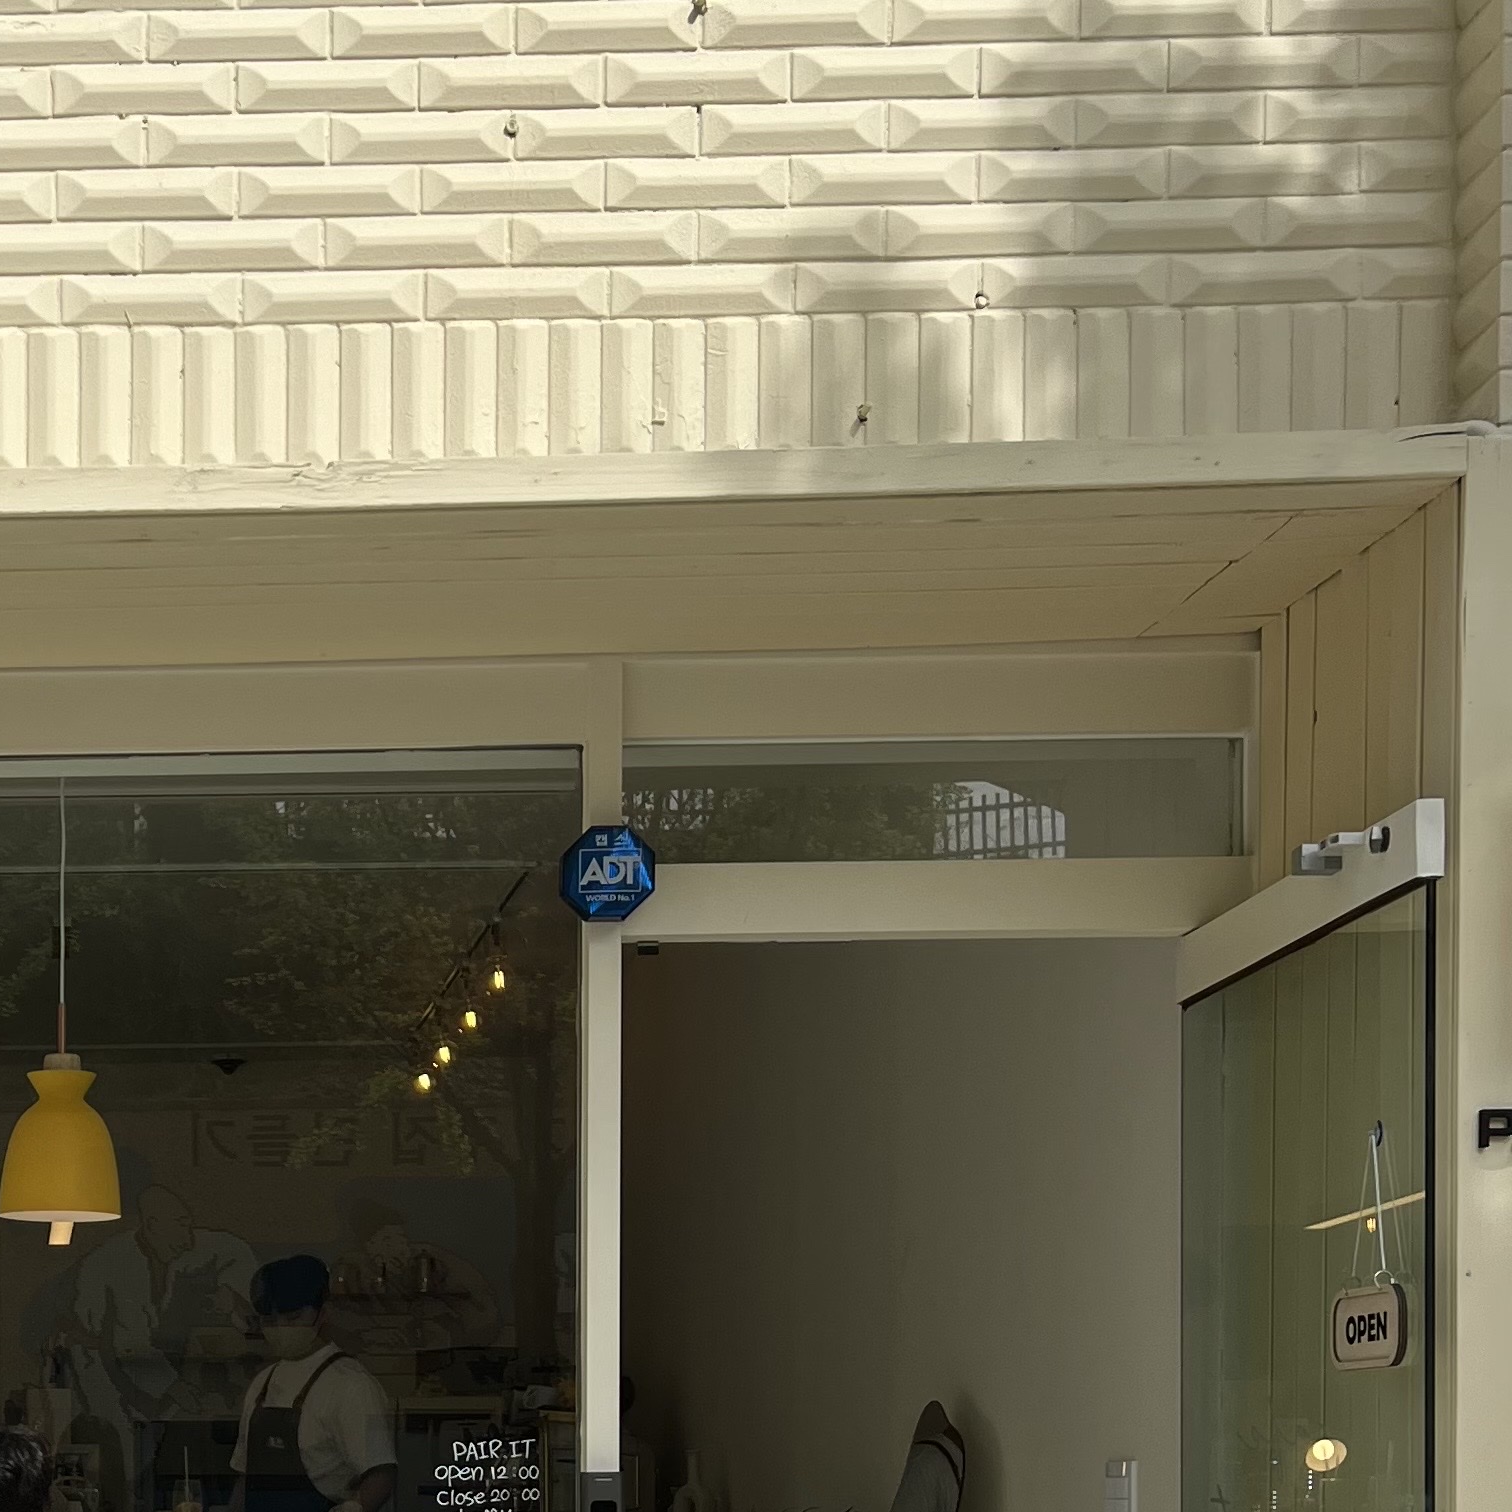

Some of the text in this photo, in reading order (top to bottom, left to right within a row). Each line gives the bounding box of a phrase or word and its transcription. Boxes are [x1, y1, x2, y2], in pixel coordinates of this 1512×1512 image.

[579, 855, 642, 886] ADT
[1345, 1310, 1388, 1346] OPEN
[452, 1438, 536, 1462] PAIR.IT
